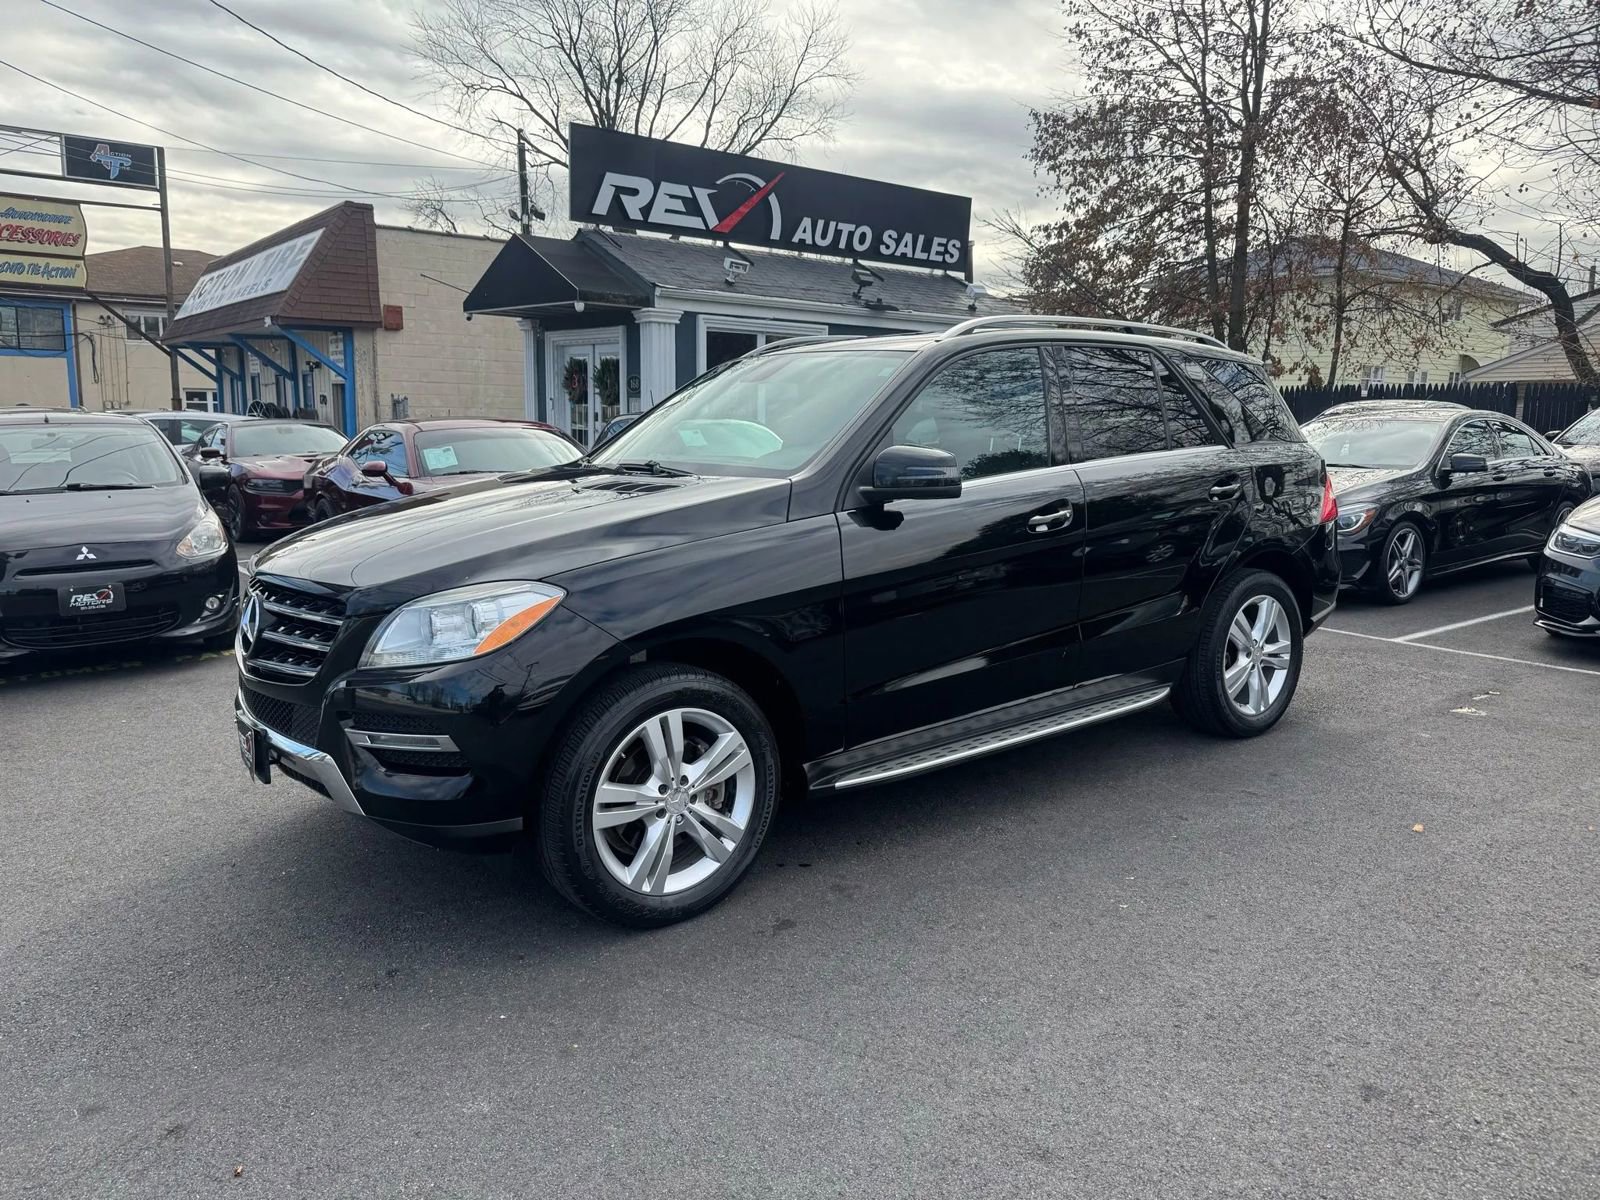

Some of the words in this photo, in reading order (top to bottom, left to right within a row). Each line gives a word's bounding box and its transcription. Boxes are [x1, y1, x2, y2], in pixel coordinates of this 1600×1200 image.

[592, 171, 785, 233] REV
[0, 223, 82, 247] CESSORIES
[792, 216, 872, 252] AUTO
[879, 229, 961, 264] SALES
[187, 258, 256, 301] ACTION
[251, 234, 319, 281] TIRE
